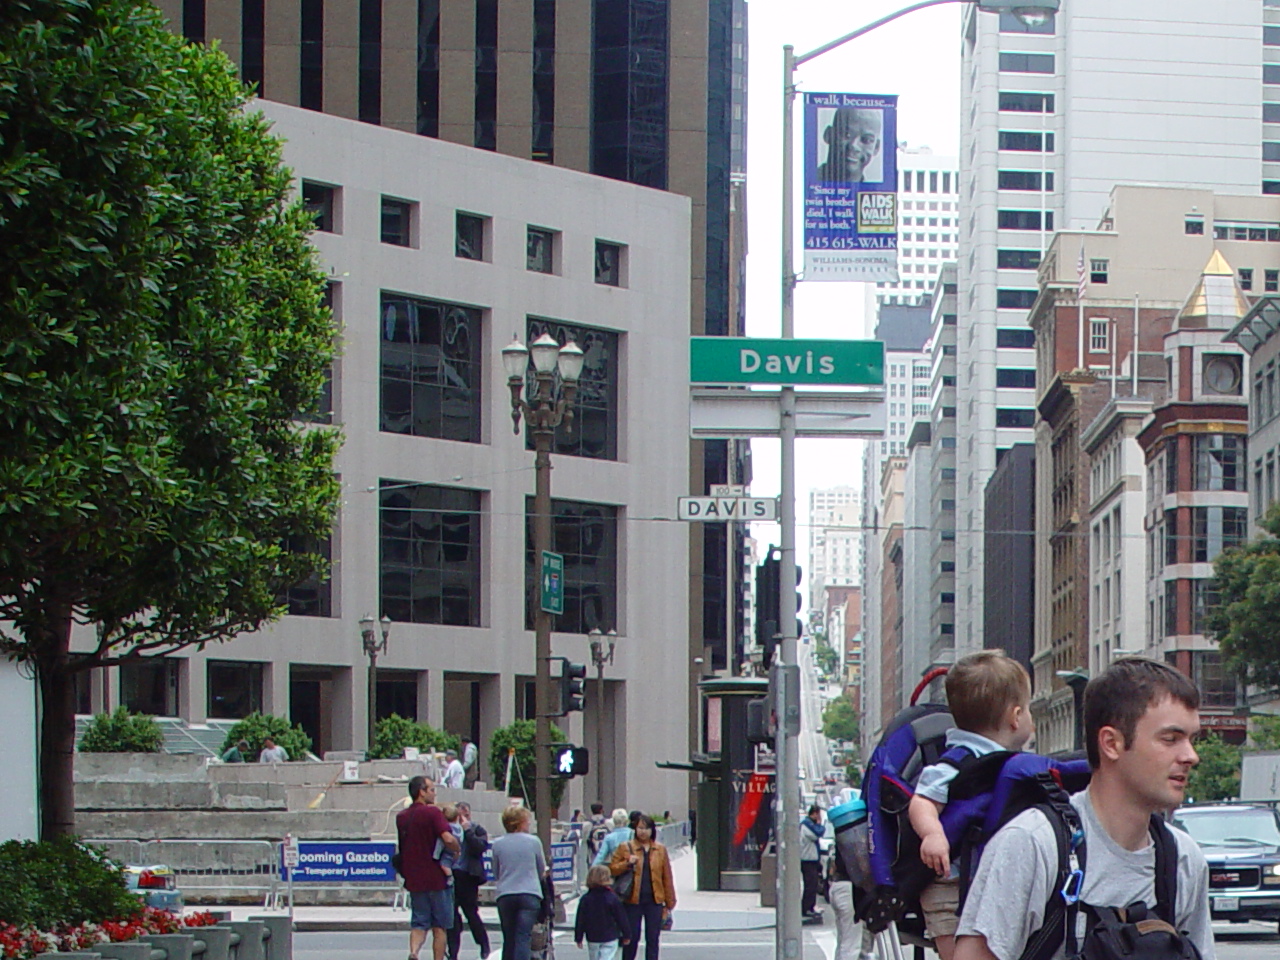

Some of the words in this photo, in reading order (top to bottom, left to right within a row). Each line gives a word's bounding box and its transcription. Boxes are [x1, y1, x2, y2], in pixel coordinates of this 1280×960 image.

[806, 93, 810, 105] I
[814, 94, 840, 106] walk
[837, 188, 851, 198] my
[826, 196, 855, 207] brother
[862, 194, 893, 208] AIDS
[834, 208, 854, 218] walk
[862, 208, 893, 220] WALK
[805, 219, 817, 229] for
[806, 236, 830, 249] 415
[832, 237, 896, 250] 615-WALK
[740, 349, 835, 375] Davis
[688, 501, 767, 517] DAVIS
[732, 781, 776, 794] VILLAG
[298, 851, 344, 865] ooming
[345, 850, 390, 863] Gazebo
[304, 866, 349, 877] Temporary
[350, 866, 387, 875] Location
